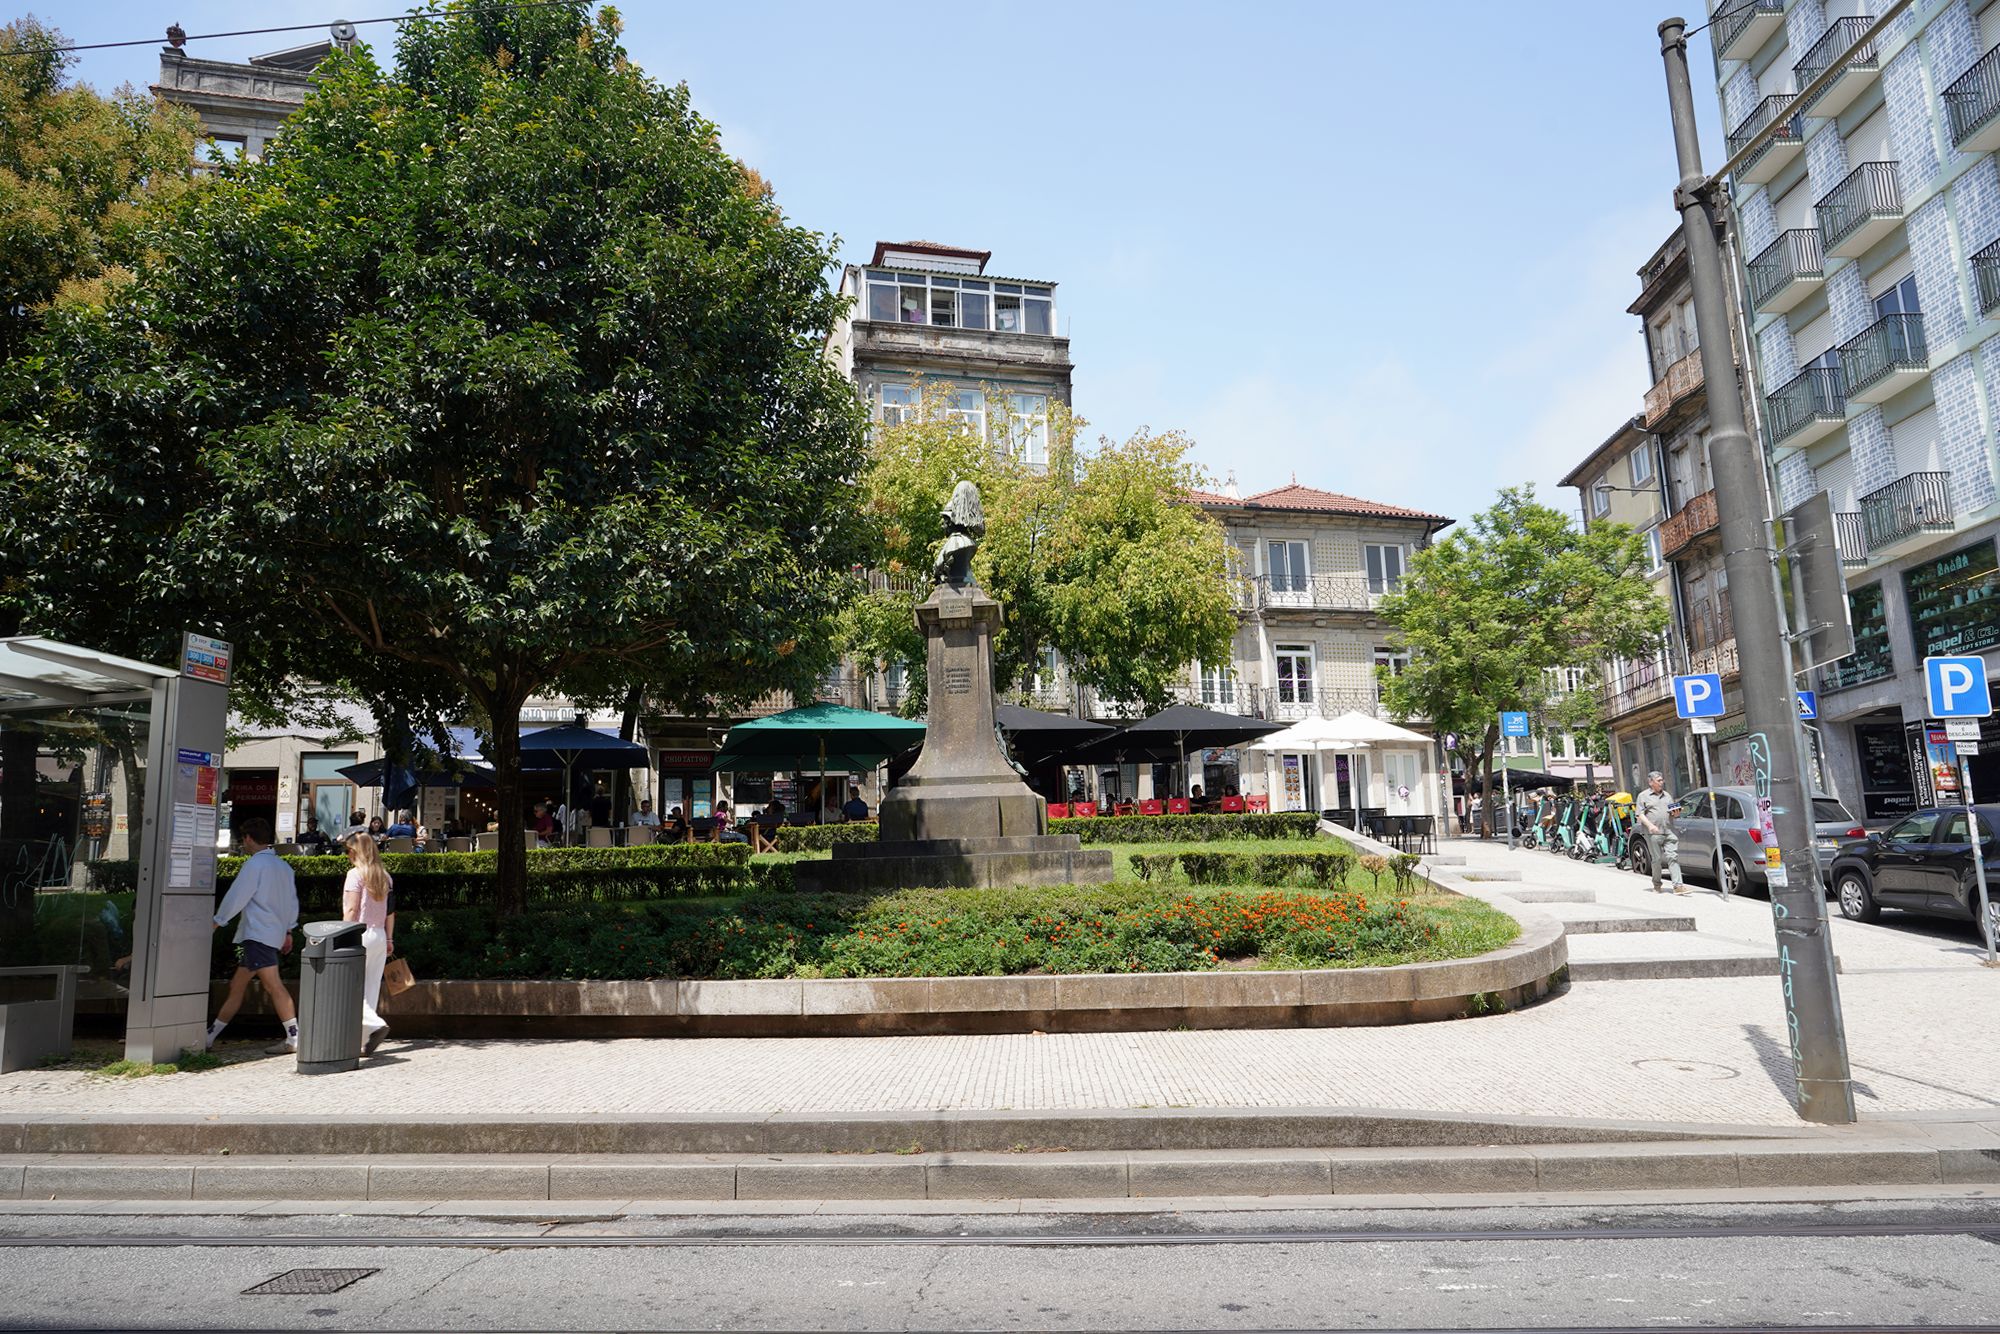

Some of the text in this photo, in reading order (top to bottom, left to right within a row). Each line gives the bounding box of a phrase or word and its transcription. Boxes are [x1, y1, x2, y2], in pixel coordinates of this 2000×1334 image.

[1928, 632, 1962, 656] papel
[1964, 628, 1975, 642] &
[1948, 637, 1995, 654] CONCEPT STORE
[1683, 679, 1711, 713] P
[1939, 663, 1973, 711] P
[684, 755, 708, 763] TATTOO
[1884, 796, 1910, 805] papel
